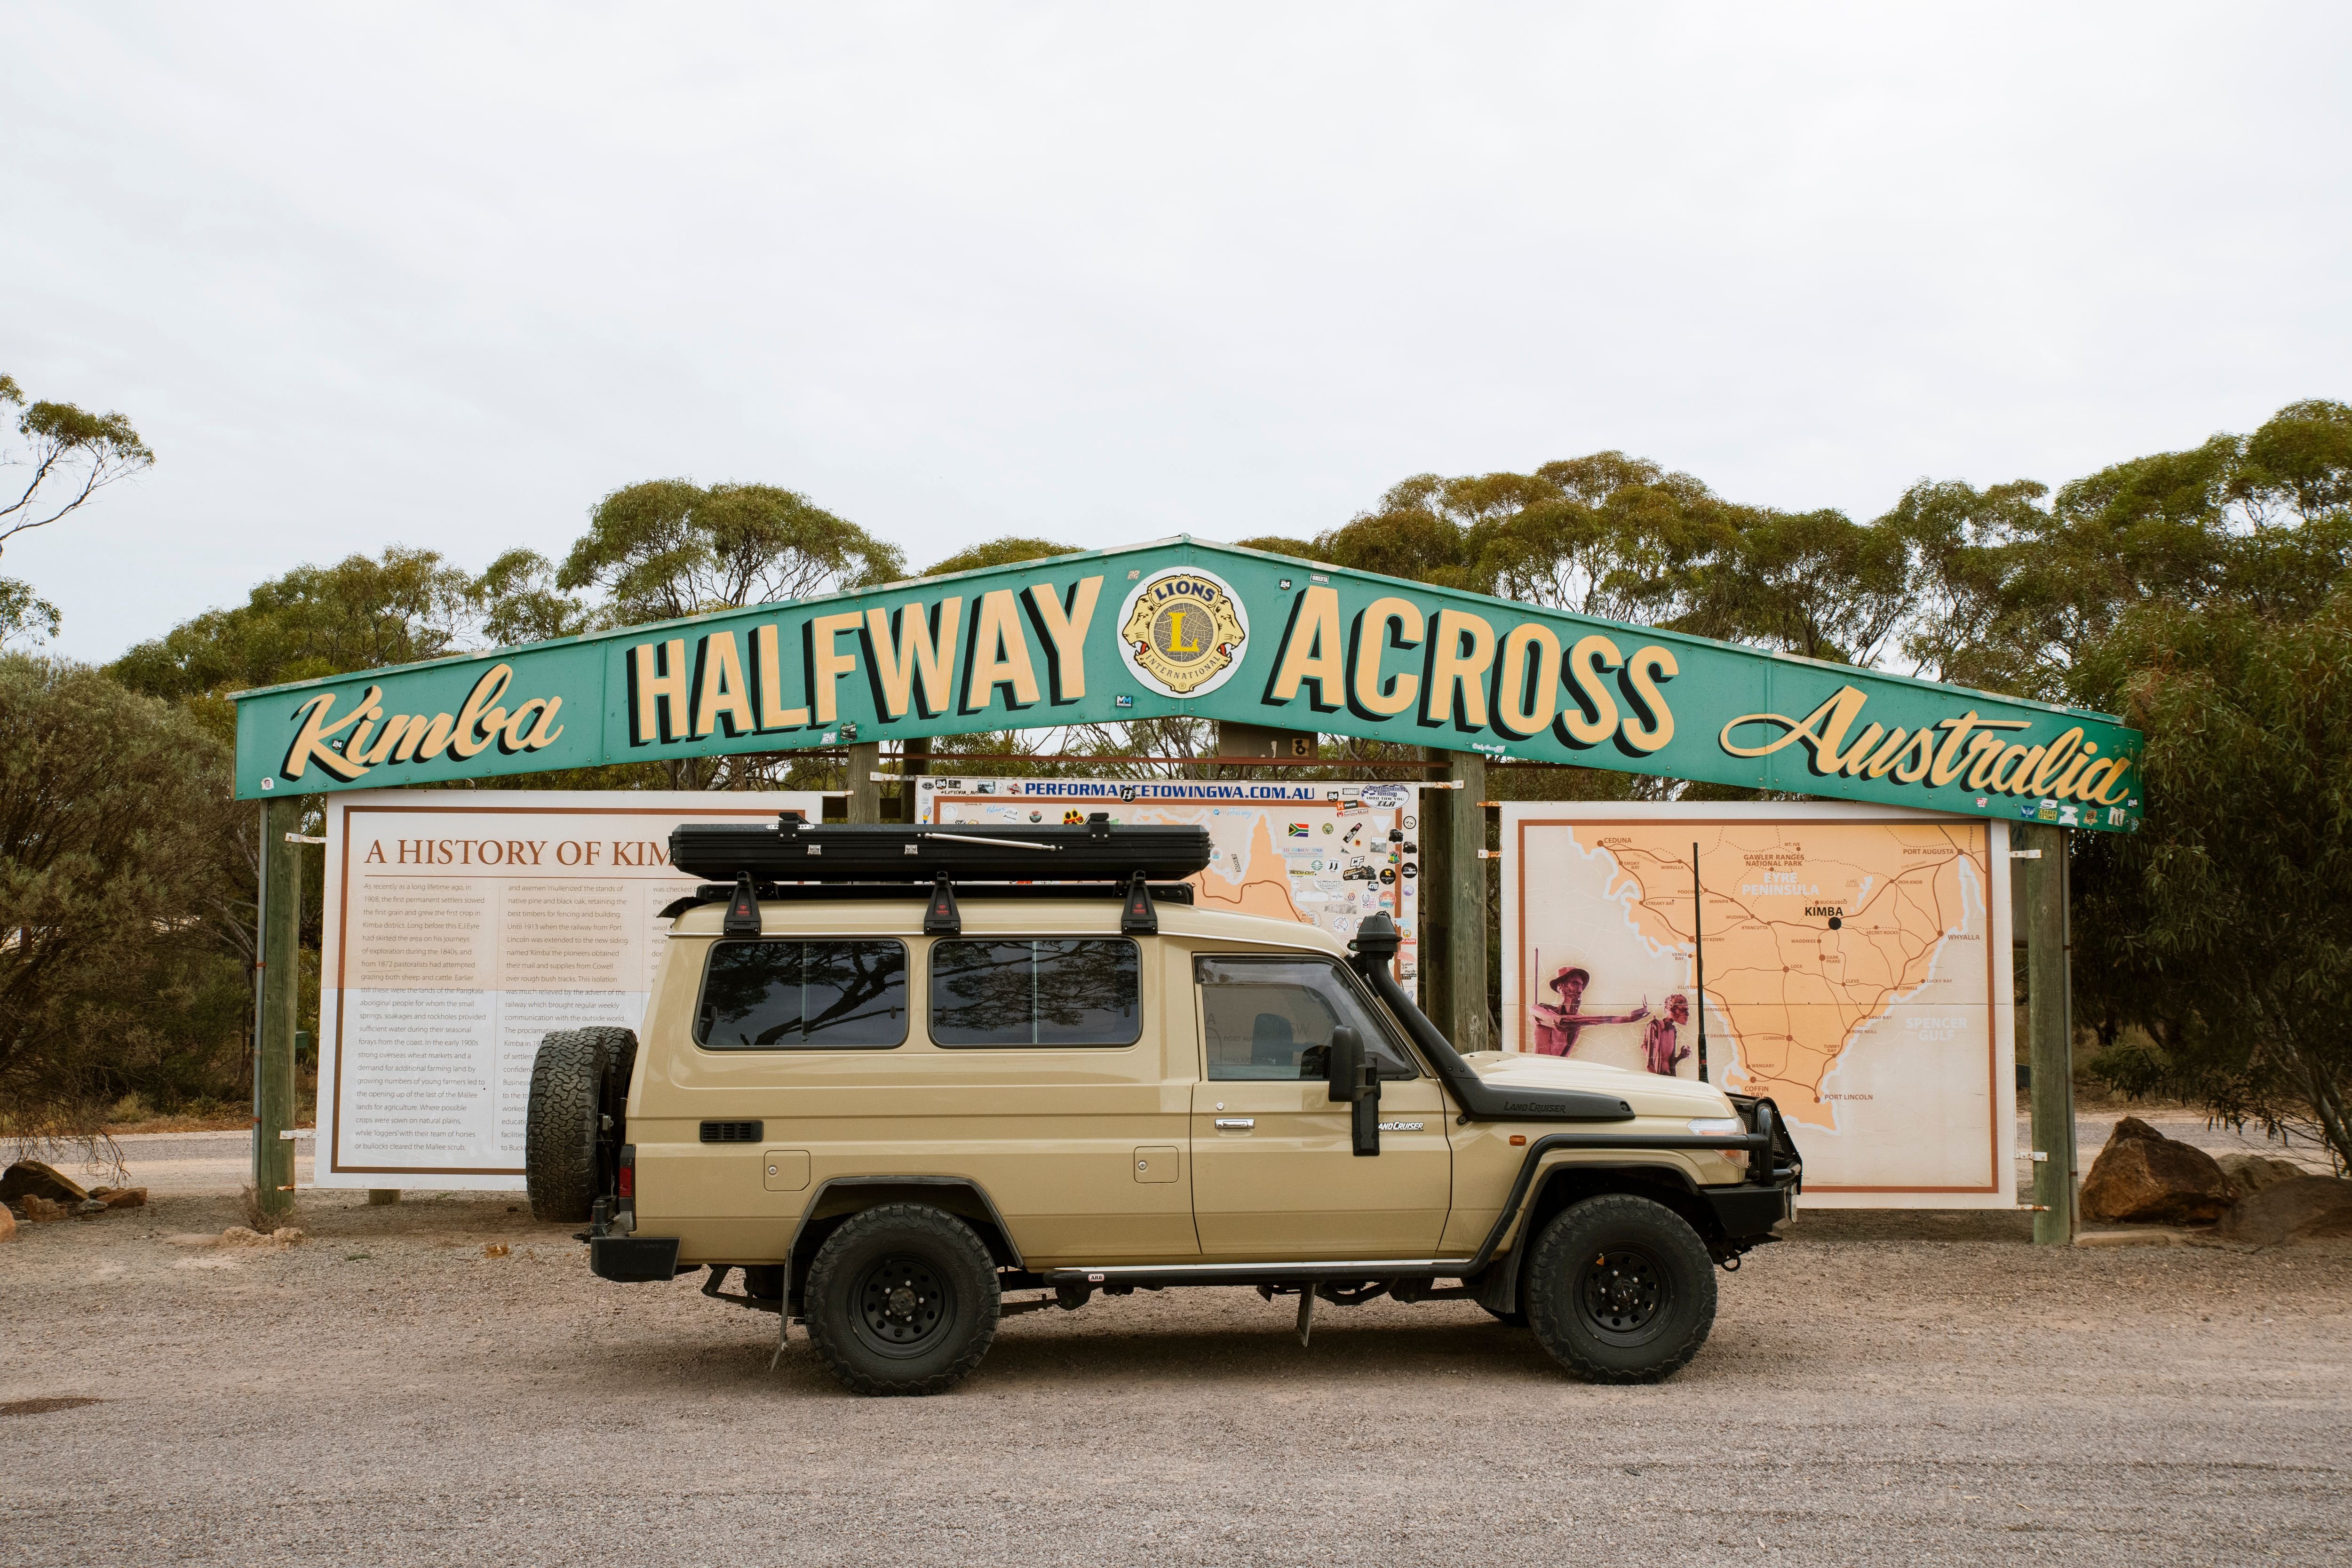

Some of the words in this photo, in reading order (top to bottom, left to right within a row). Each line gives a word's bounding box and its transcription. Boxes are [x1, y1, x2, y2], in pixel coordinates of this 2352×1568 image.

[1154, 581, 1215, 602] LIONS
[1167, 612, 1199, 652] L
[627, 575, 1104, 747] HALFWAY
[1145, 654, 1220, 680] INTERNATIONAL
[1262, 586, 1679, 757] ACROSS
[280, 663, 564, 782] Kimba
[1718, 685, 2130, 809] Australia
[364, 839, 387, 864] A
[397, 839, 548, 866] HISTORY
[556, 841, 601, 866] OF
[1742, 885, 1819, 895] PENINSULA
[1764, 873, 1797, 883] EYRE
[1805, 907, 1843, 916] KIMBA
[1906, 1018, 1967, 1029] SPENCER
[1919, 1030, 1955, 1041] GULF
